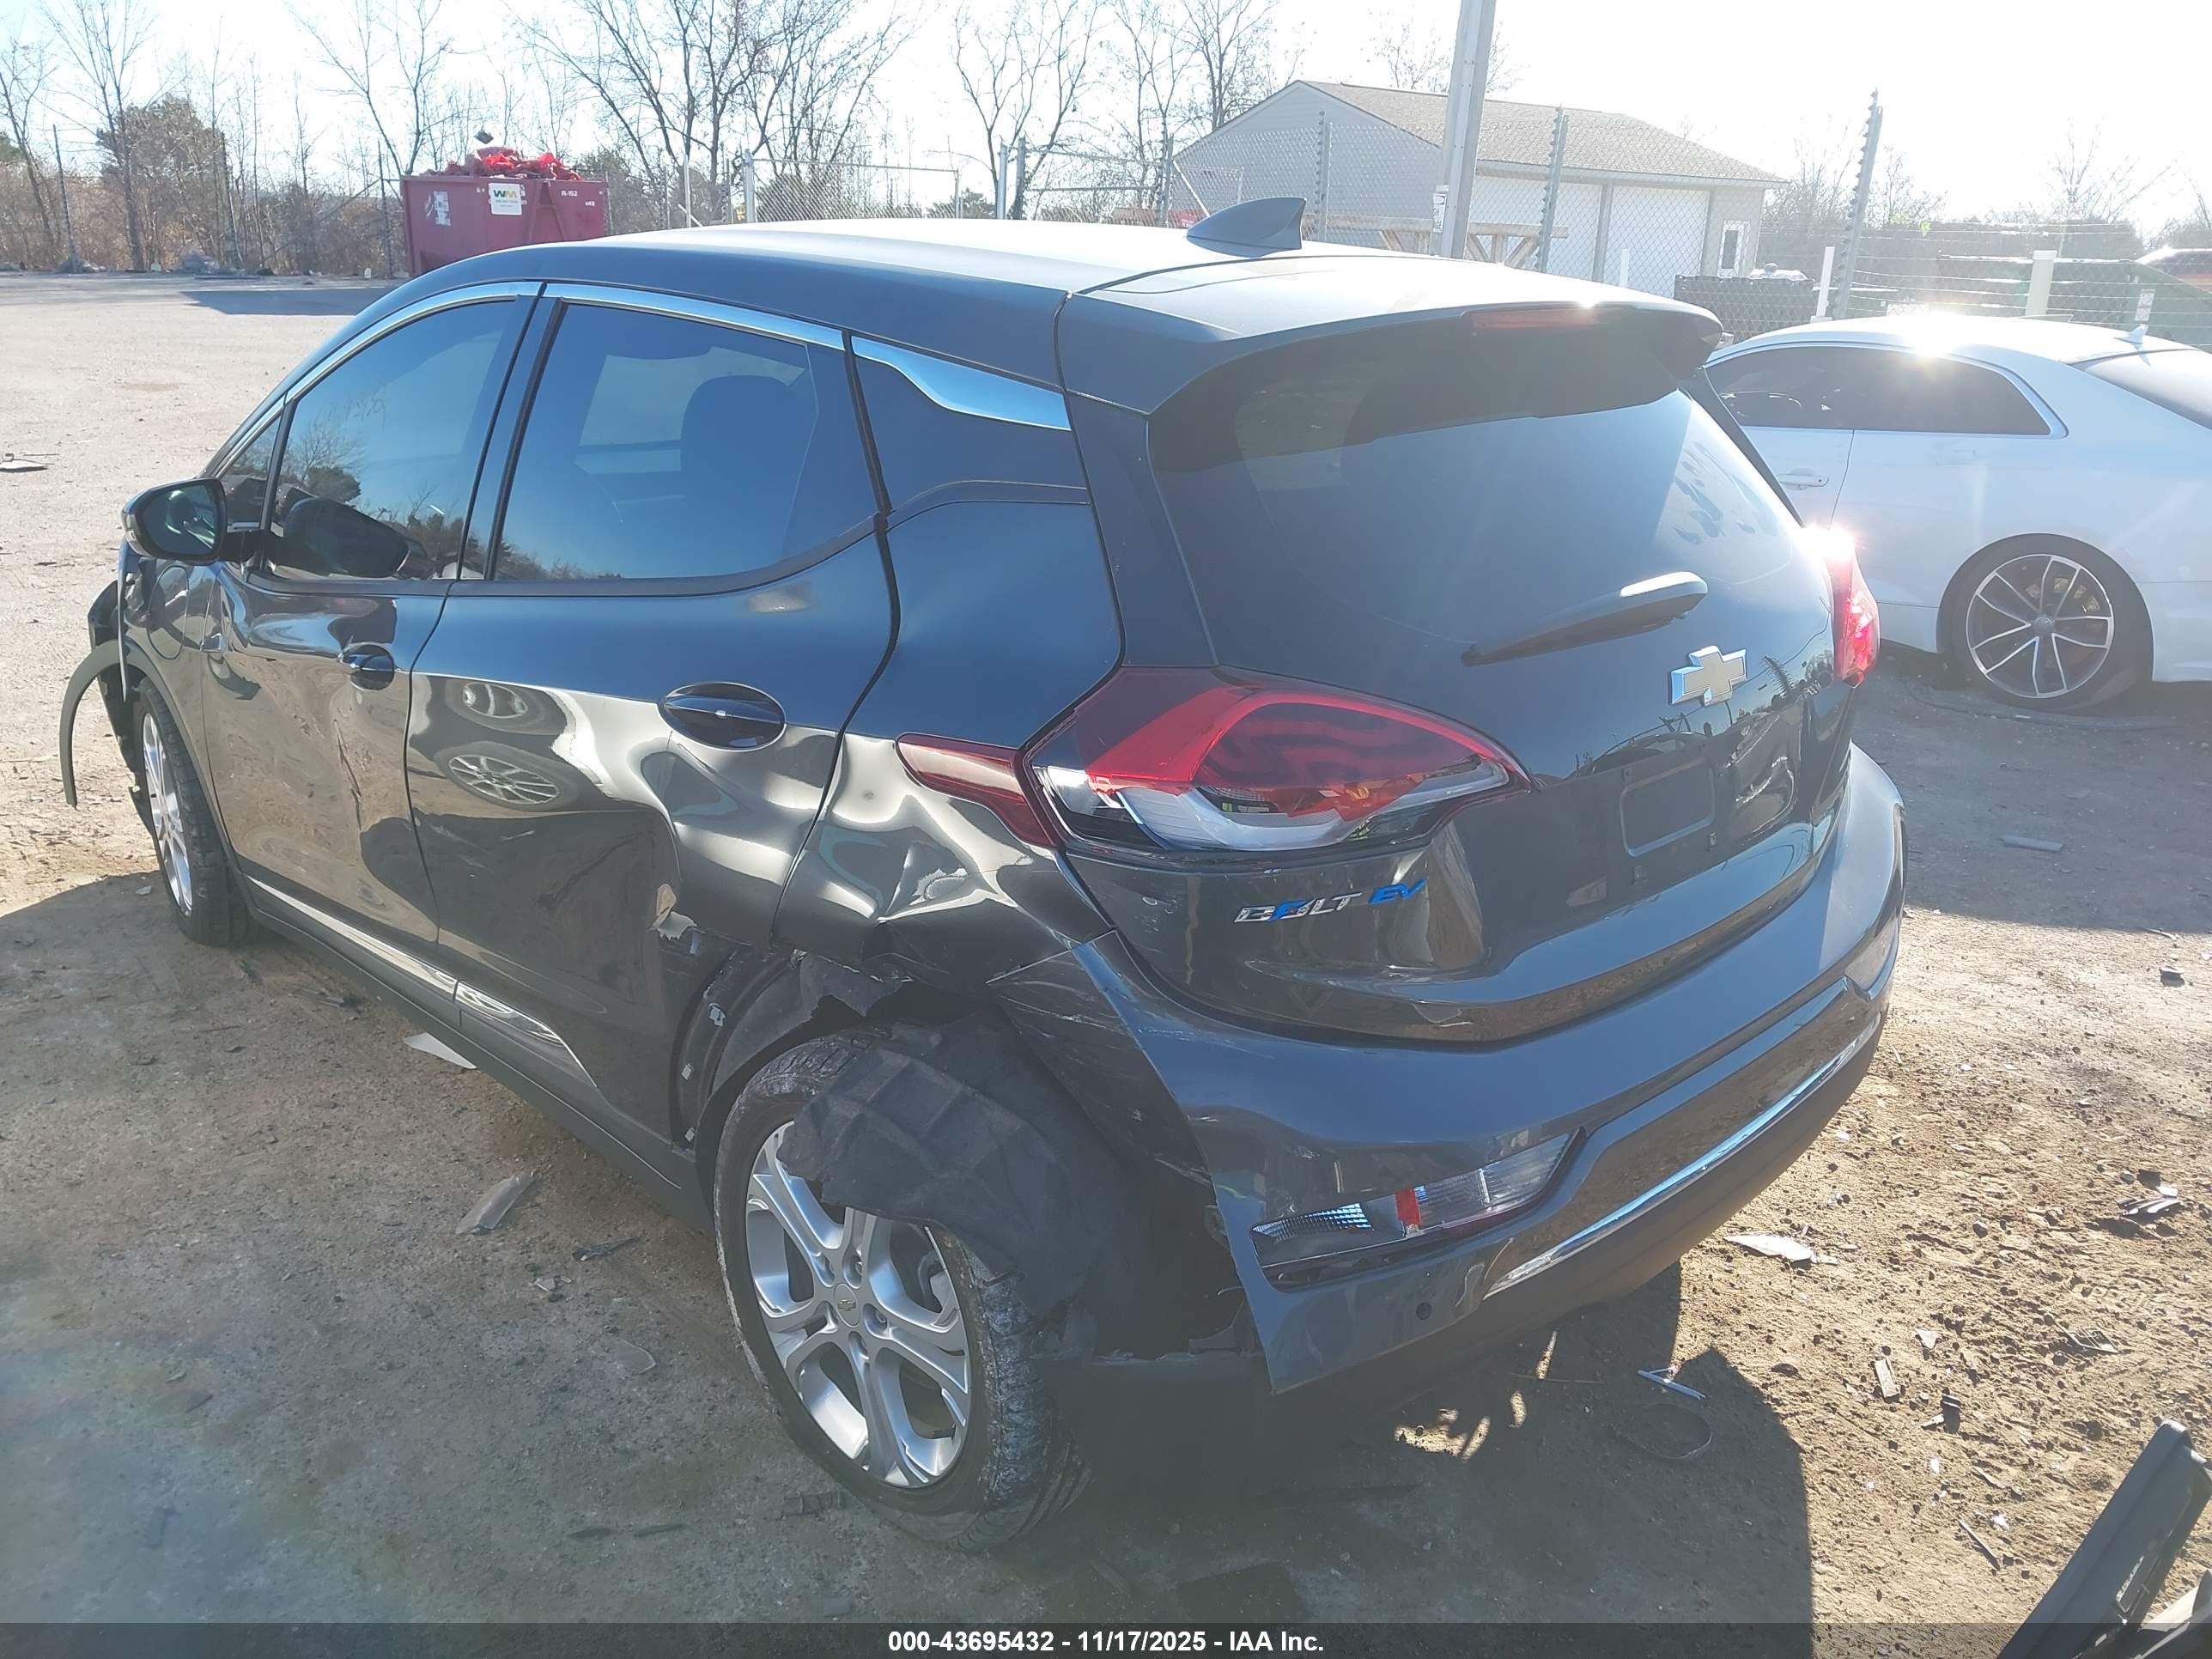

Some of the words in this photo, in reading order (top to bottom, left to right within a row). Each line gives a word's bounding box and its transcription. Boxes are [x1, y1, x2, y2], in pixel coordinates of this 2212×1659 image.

[493, 189, 518, 198] WM
[1234, 892, 1363, 923] BOLT
[1368, 878, 1427, 907] EV
